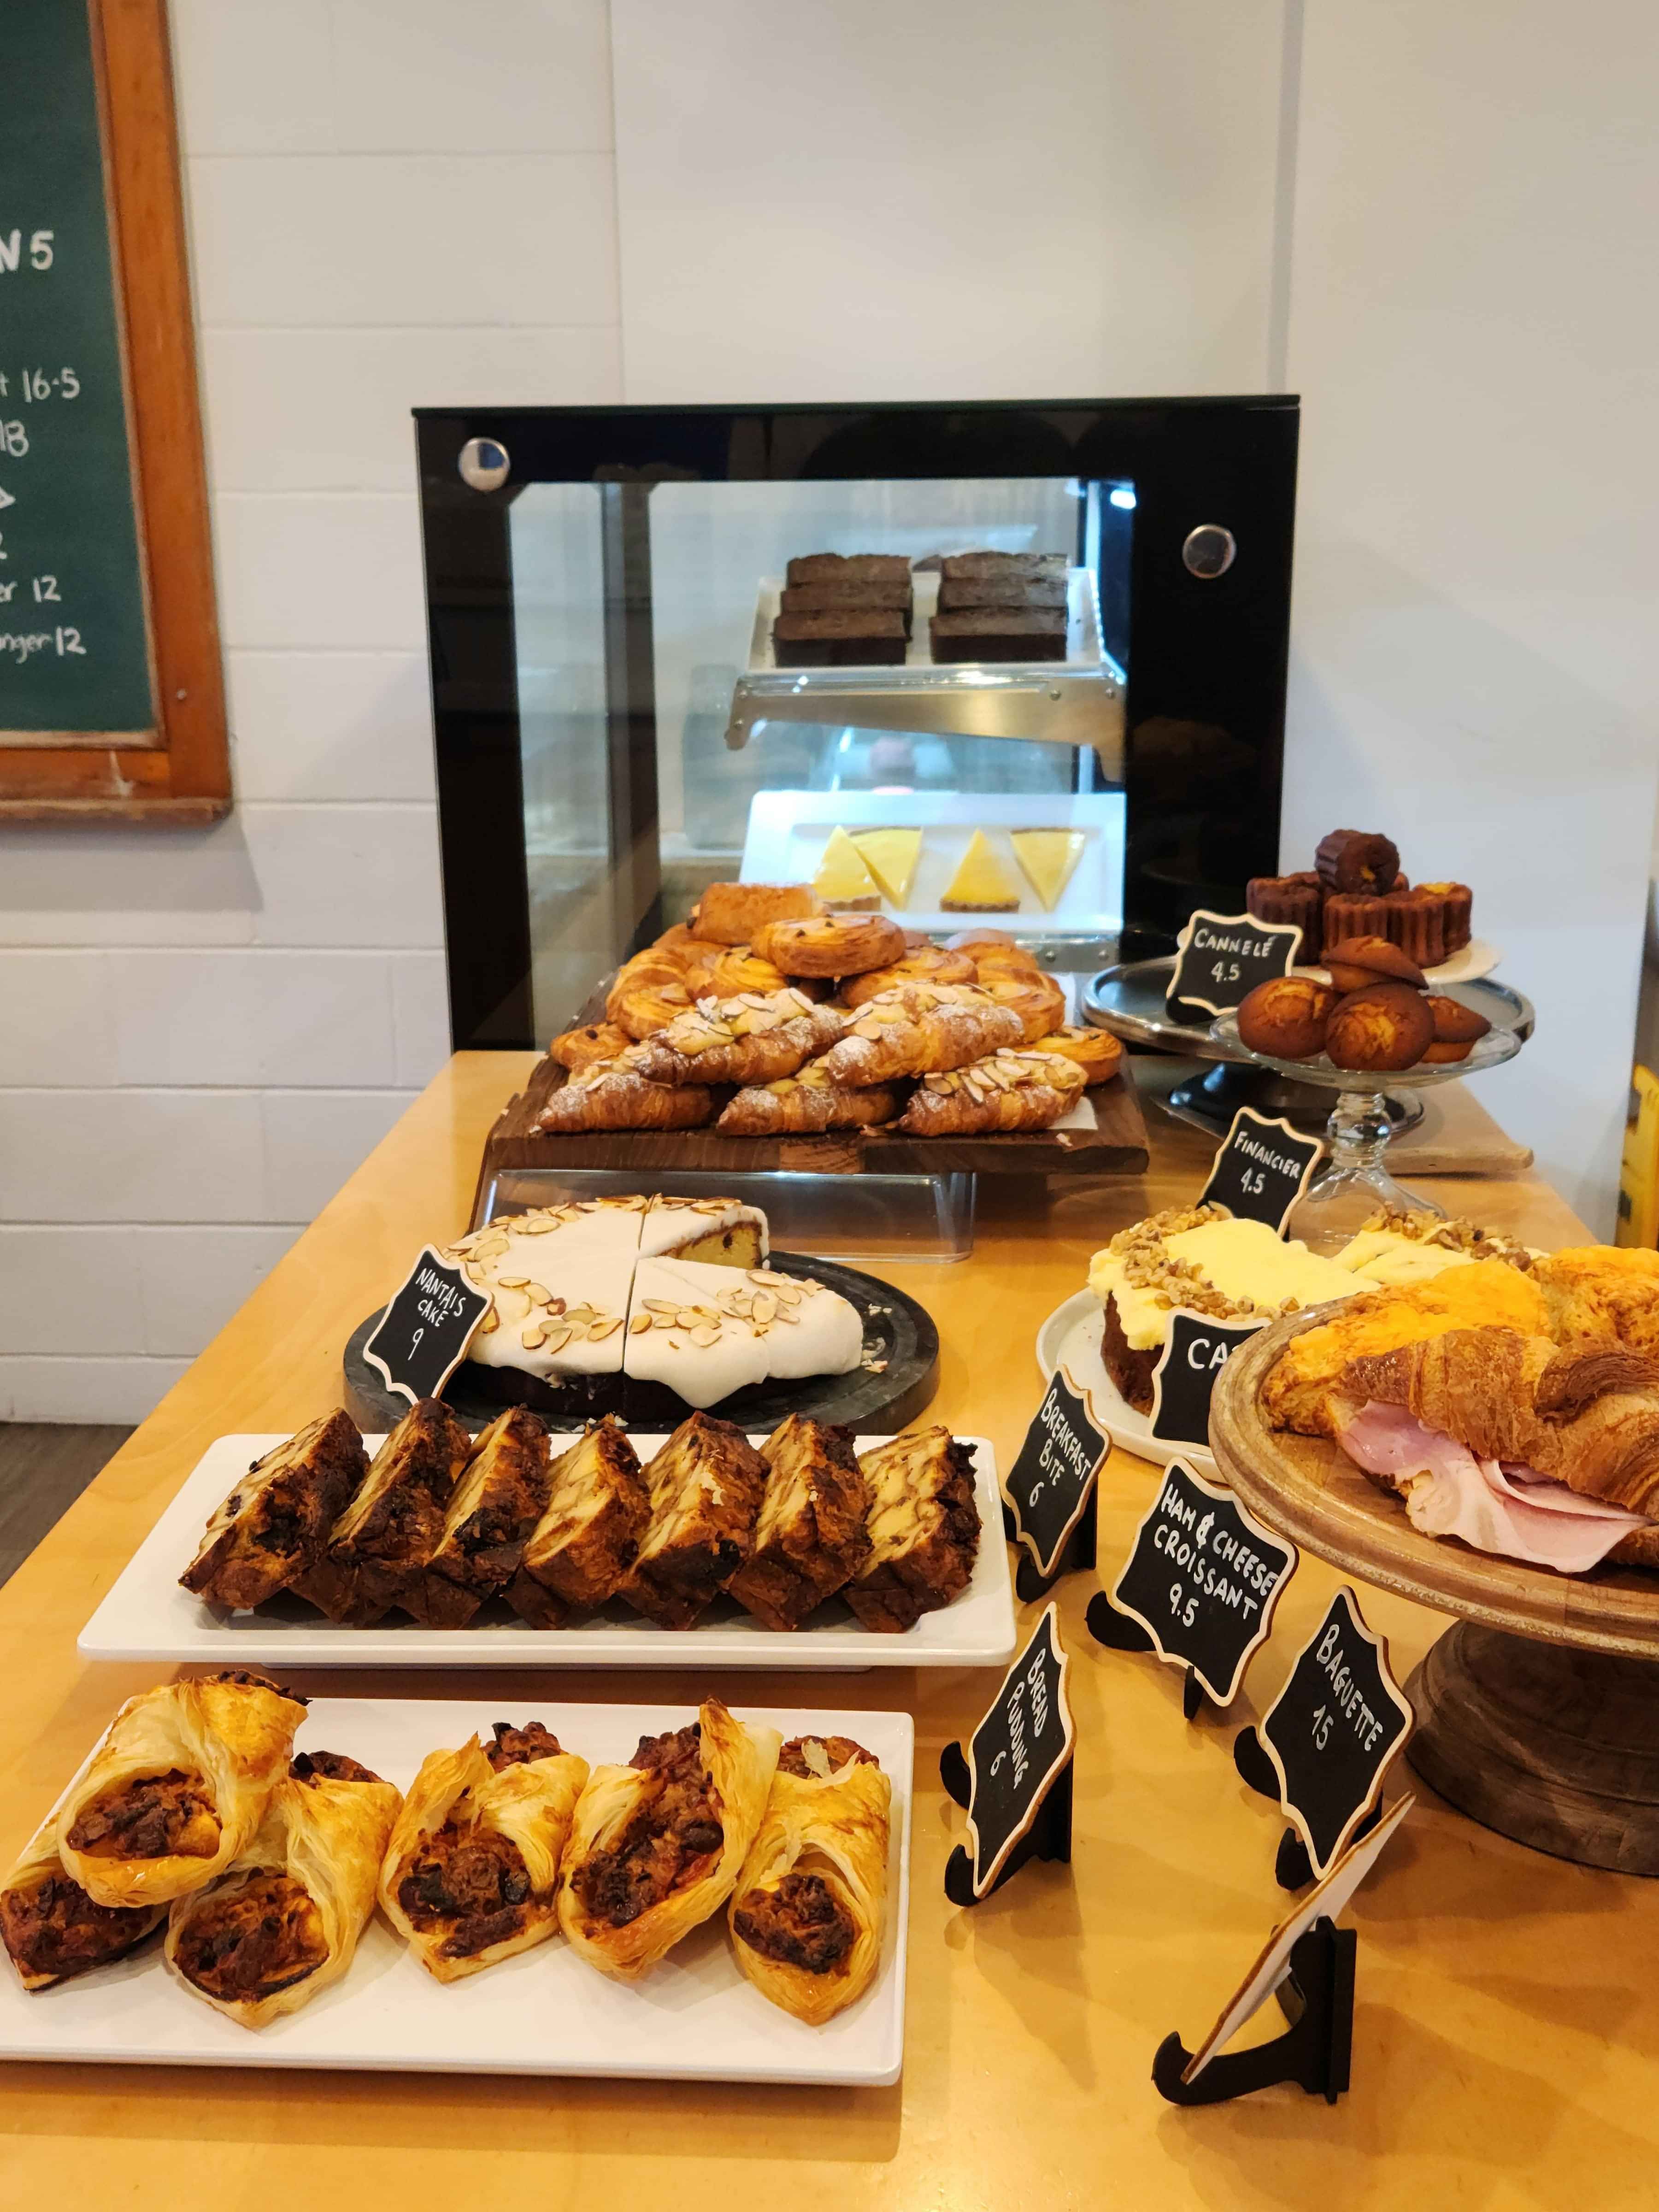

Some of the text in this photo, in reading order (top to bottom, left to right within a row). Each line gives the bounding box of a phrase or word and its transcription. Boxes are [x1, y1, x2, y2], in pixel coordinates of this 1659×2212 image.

[30, 230, 54, 270] 5
[33, 575, 62, 603] 12
[55, 625, 87, 656] 12
[1194, 928, 1279, 958] CANNELÉ
[1210, 961, 1240, 983] 4.5
[1234, 1130, 1302, 1179] FINANCIER
[1240, 1166, 1266, 1194] 4.5
[415, 1268, 466, 1317] NANTAIS
[418, 1299, 449, 1327] CAKE
[407, 1328, 424, 1361] 9
[1187, 1338, 1240, 1370] CA
[1040, 1387, 1092, 1481] BREAKFAST
[1038, 1438, 1065, 1487] BITE
[1029, 1481, 1045, 1508] 6
[1161, 1483, 1197, 1531] HAM
[1212, 1530, 1280, 1596] CHEESE
[1153, 1524, 1258, 1620] CROISSANT
[1169, 1583, 1200, 1627] 9.5
[1027, 1647, 1048, 1738] BREAD
[1316, 1624, 1383, 1752] BAGUETTE
[1006, 1681, 1029, 1790] PUDDING
[1312, 1704, 1335, 1751] 15
[990, 1750, 1007, 1777] 6
